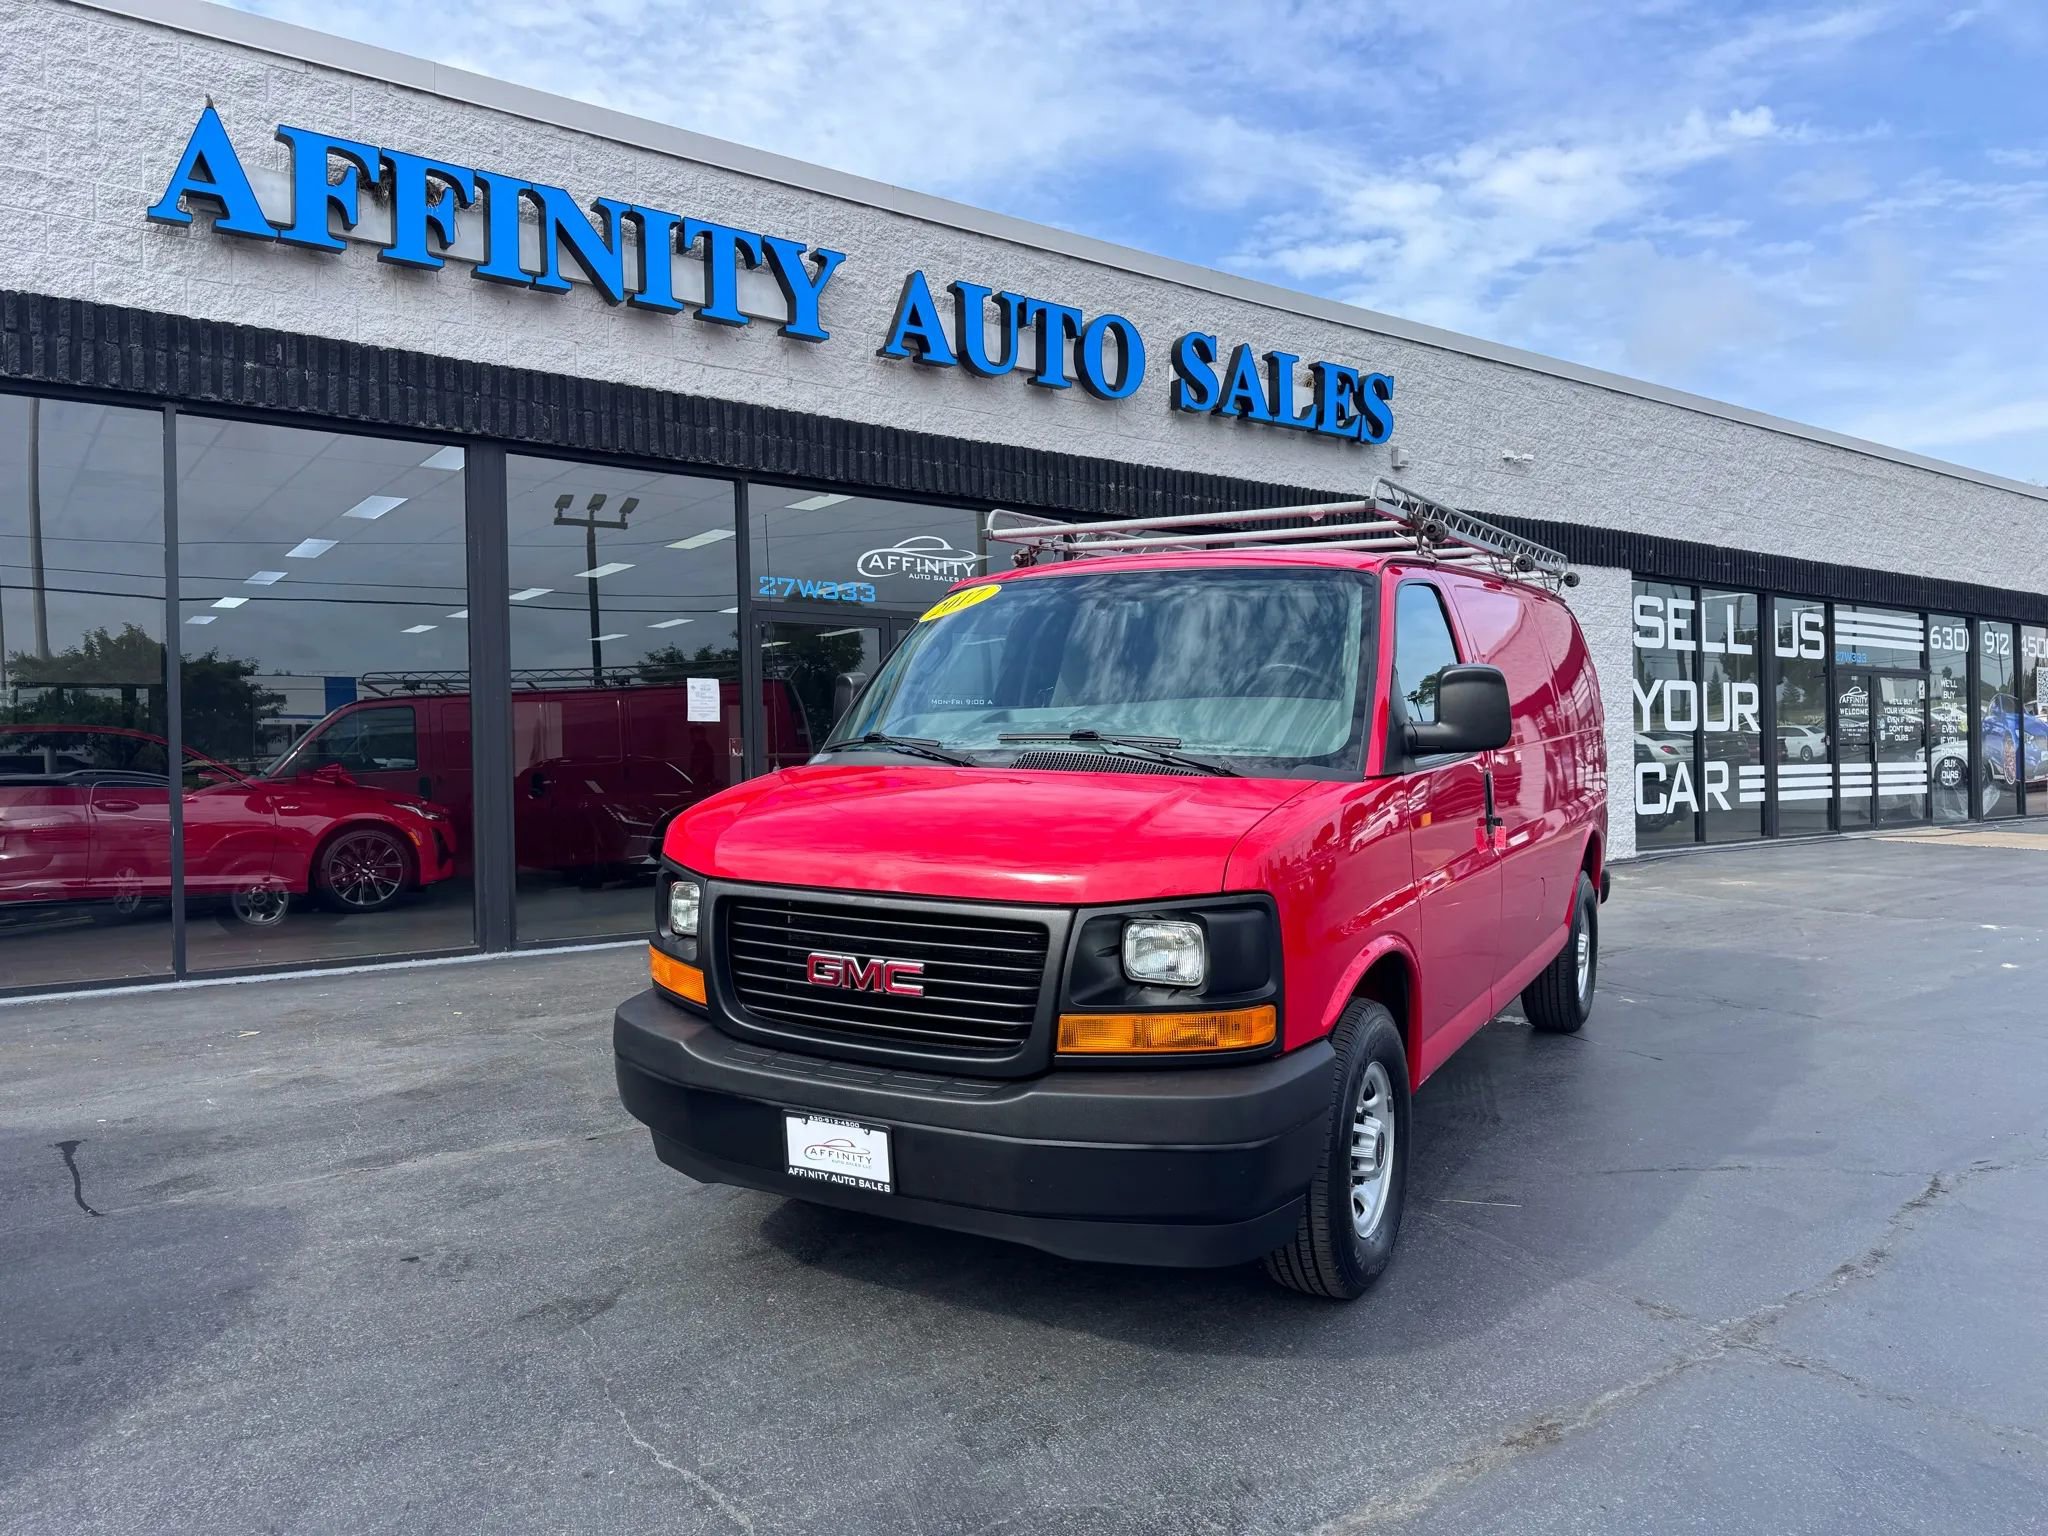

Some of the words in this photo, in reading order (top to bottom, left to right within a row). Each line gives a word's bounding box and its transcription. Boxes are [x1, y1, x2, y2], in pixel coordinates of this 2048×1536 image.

[147, 106, 846, 342] AFFINITY
[877, 270, 1145, 400] AUTO
[1171, 332, 1394, 445] SALES
[869, 554, 975, 577] AFFINITY
[909, 572, 931, 581] AUTO
[934, 575, 959, 583] SALES
[1633, 595, 1752, 655] SELL
[1774, 609, 1825, 659] US
[1984, 631, 2010, 655] 912
[2021, 635, 2048, 658] 450
[1842, 696, 1868, 704] AFFINITY
[1943, 691, 1955, 699] BUY
[1632, 679, 1761, 733] YOUR
[1942, 725, 1958, 733] EVEN
[1947, 736, 1959, 744] YOU
[1944, 759, 1956, 767] BUY
[1942, 770, 1959, 778] OURS
[1636, 761, 1732, 815] CAR
[806, 951, 925, 997] GMC
[810, 1147, 872, 1165] AFFINITY
[788, 1166, 829, 1181] AFFINITY
[831, 1174, 856, 1186] AUTO
[858, 1179, 891, 1193] SALES
